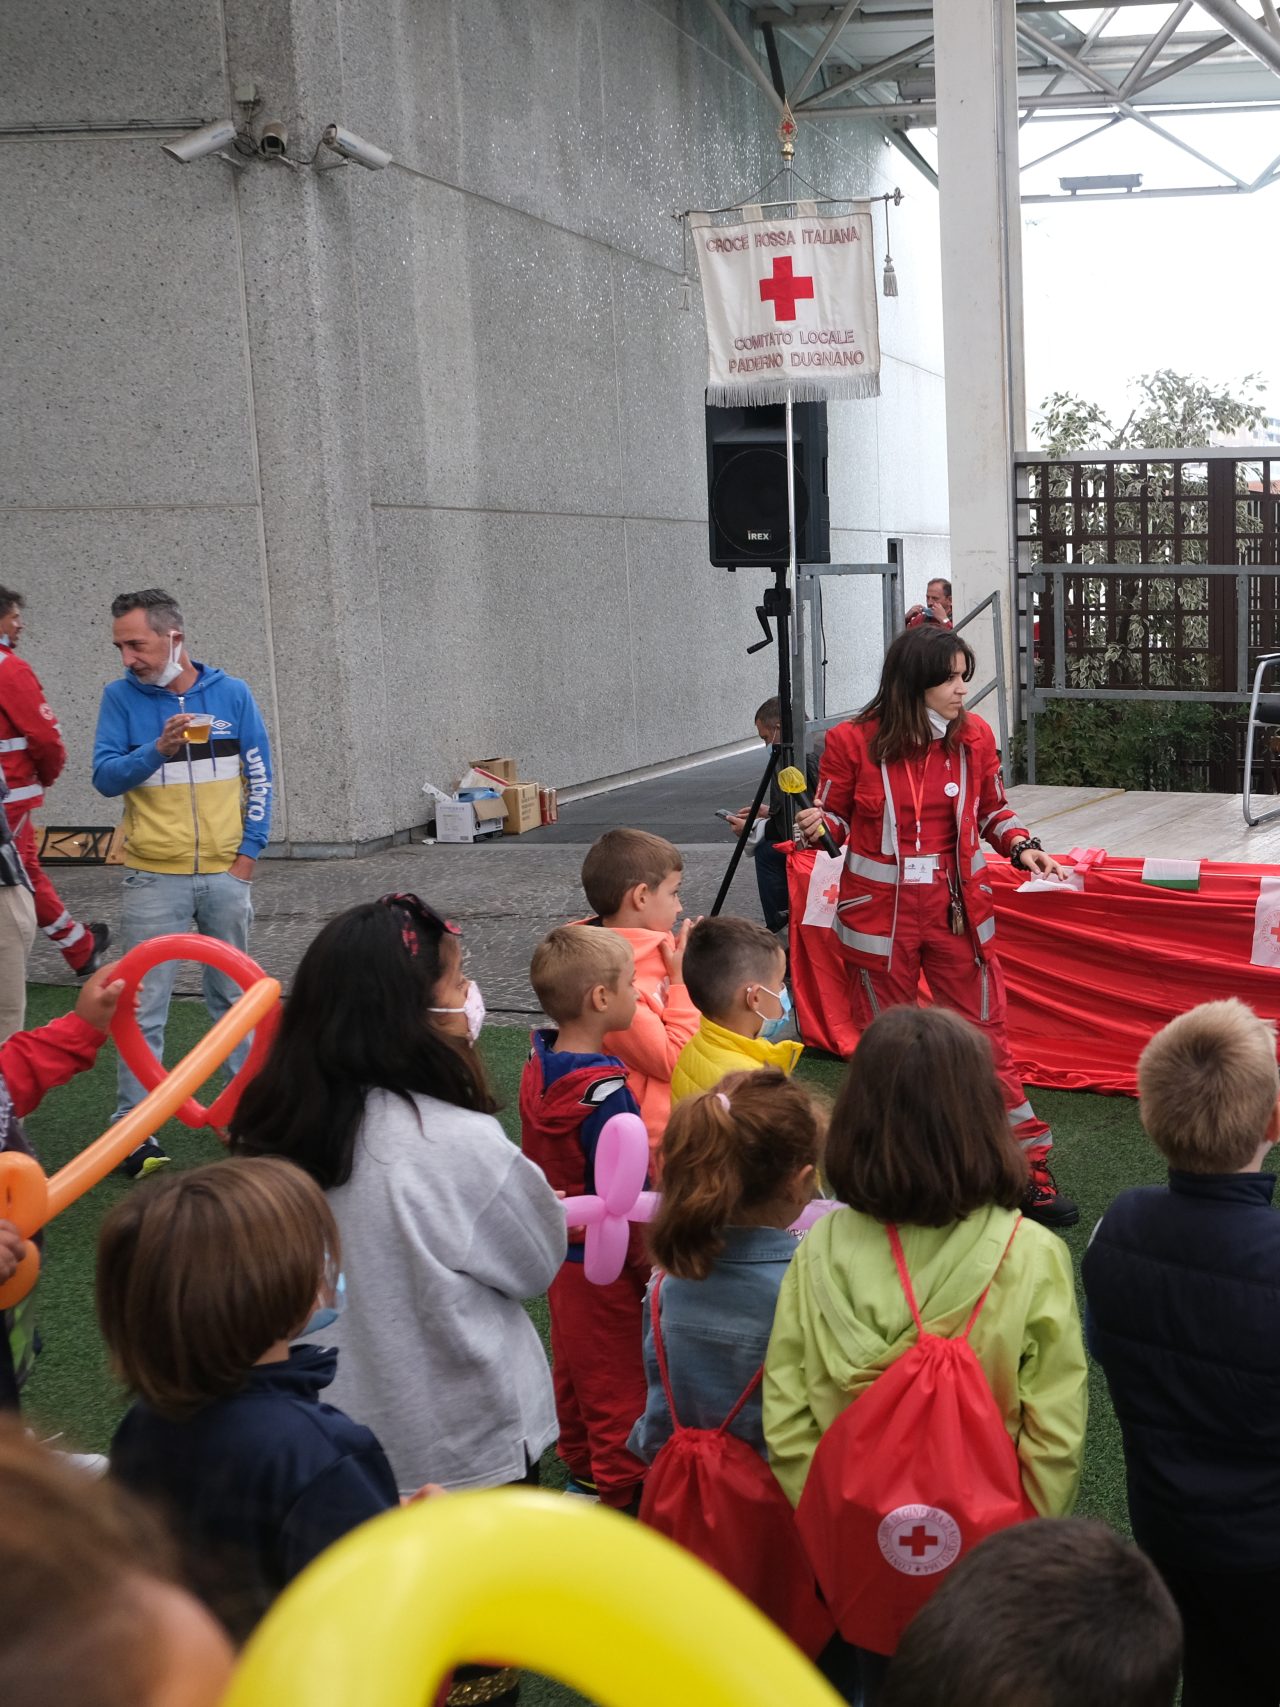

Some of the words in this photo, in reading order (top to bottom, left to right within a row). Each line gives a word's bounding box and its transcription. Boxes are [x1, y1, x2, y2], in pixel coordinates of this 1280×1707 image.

[705, 234, 749, 254] CROCE
[754, 230, 796, 248] ROSSA
[801, 226, 860, 245] ITALIANA
[734, 331, 793, 350] COMITATO
[799, 330, 855, 345] LOCALE
[728, 353, 784, 374] PADERNO
[790, 350, 865, 367] DUGNANO
[246, 746, 272, 822] umbro
